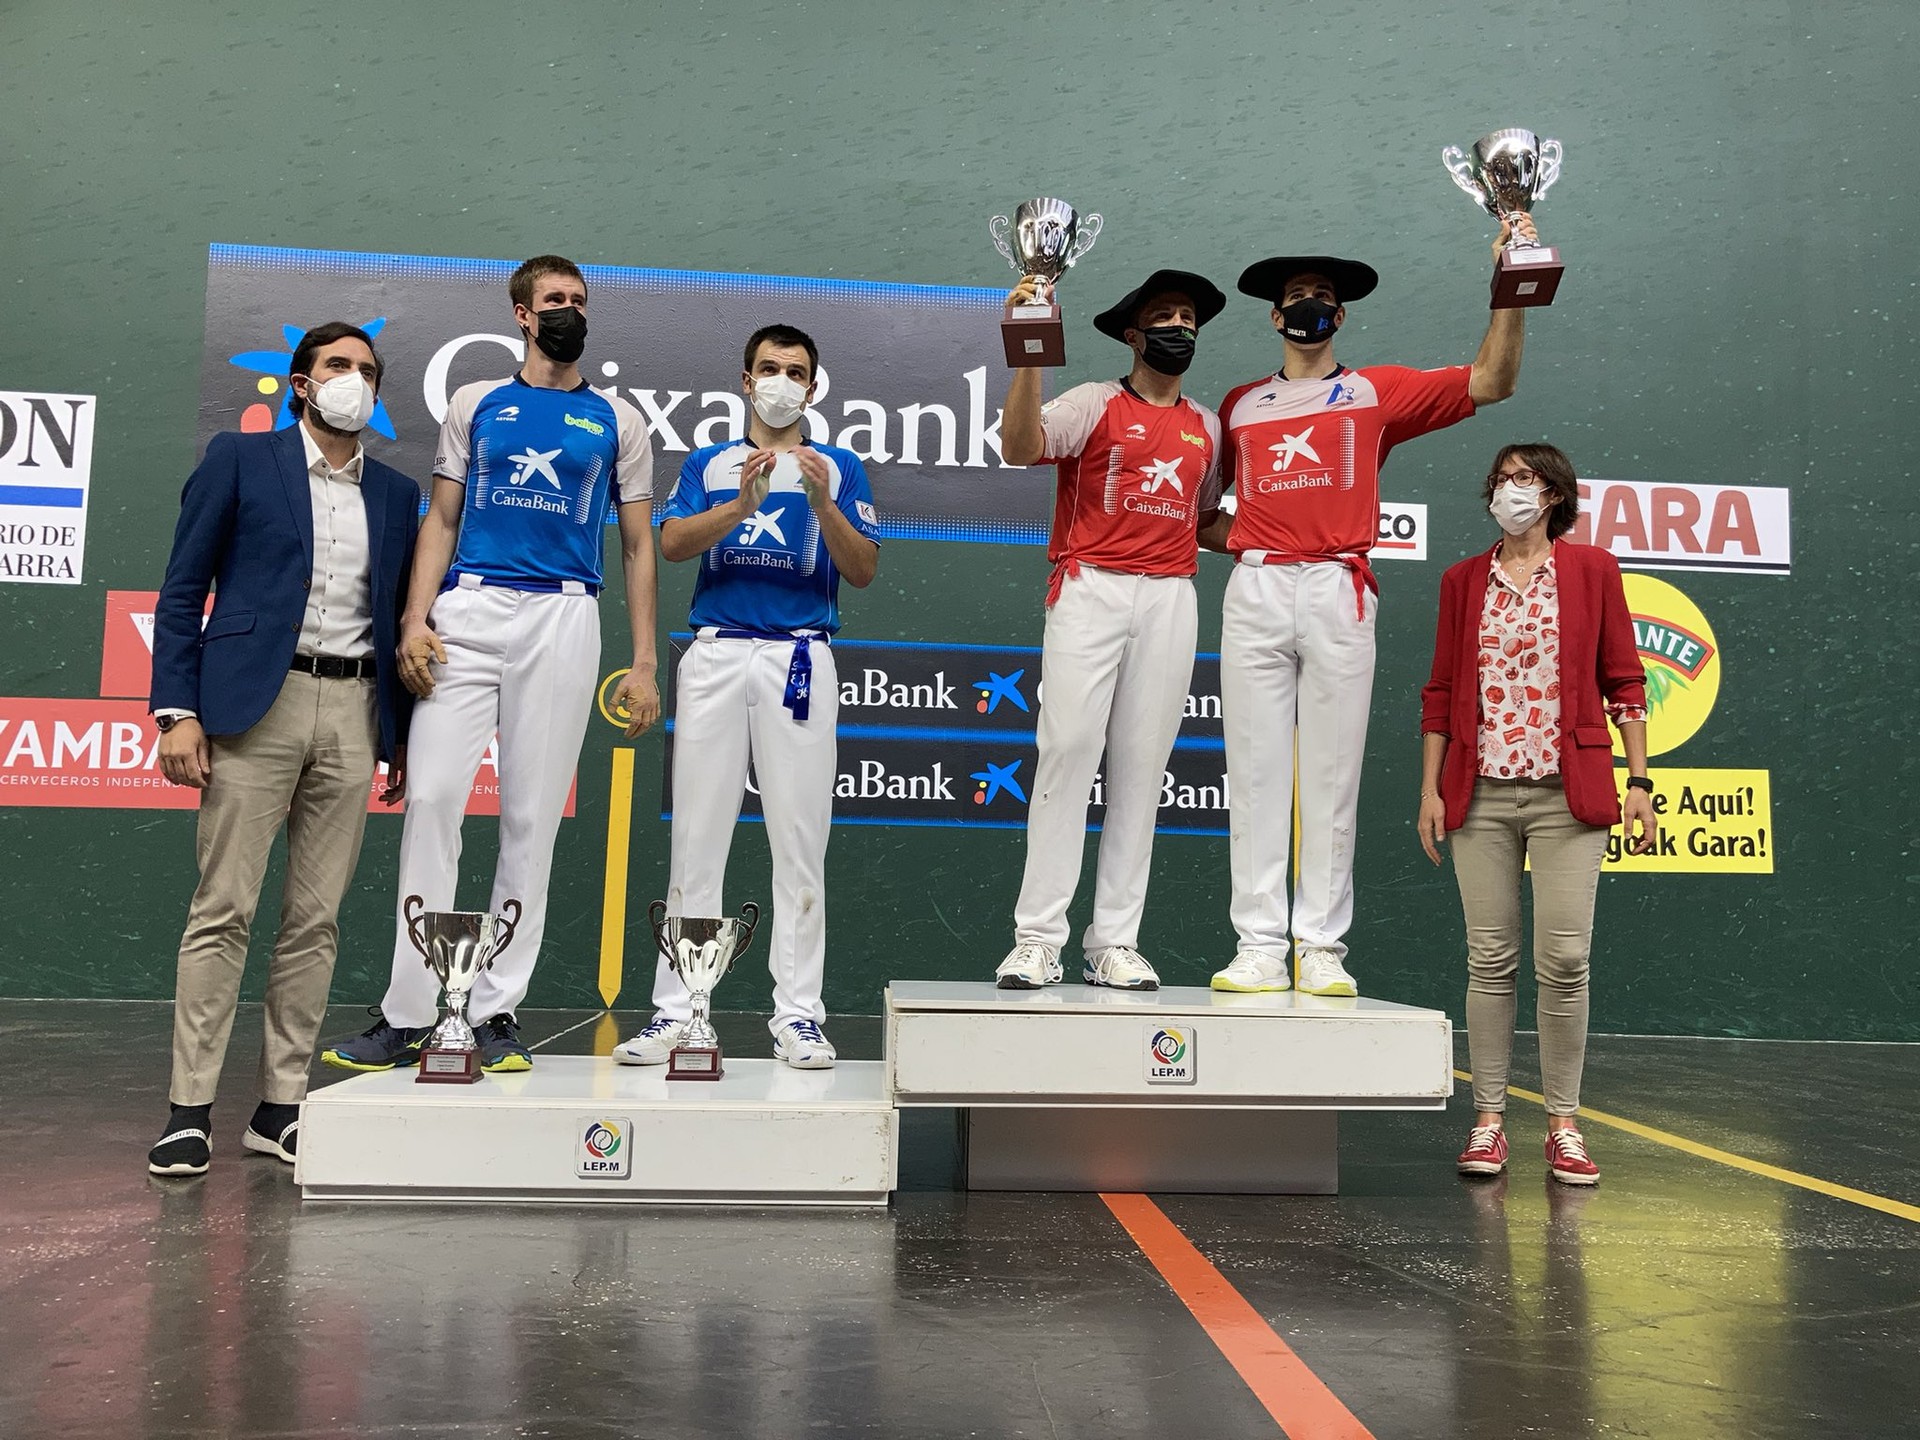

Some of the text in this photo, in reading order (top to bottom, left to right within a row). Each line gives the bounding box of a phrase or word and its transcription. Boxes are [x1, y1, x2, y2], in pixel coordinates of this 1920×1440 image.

[1258, 472, 1334, 494] CaixaBank
[491, 490, 569, 516] CaixaBank
[1123, 496, 1187, 521] CaixaBank
[40, 525, 76, 547] DE
[723, 550, 794, 571] CaixaBank
[0, 774, 100, 787] CERVECEROS
[1677, 786, 1755, 822] Aquí!
[1688, 827, 1767, 858] Gara!
[1152, 1067, 1186, 1077] LEP.M
[583, 1161, 620, 1171] LEP.M
